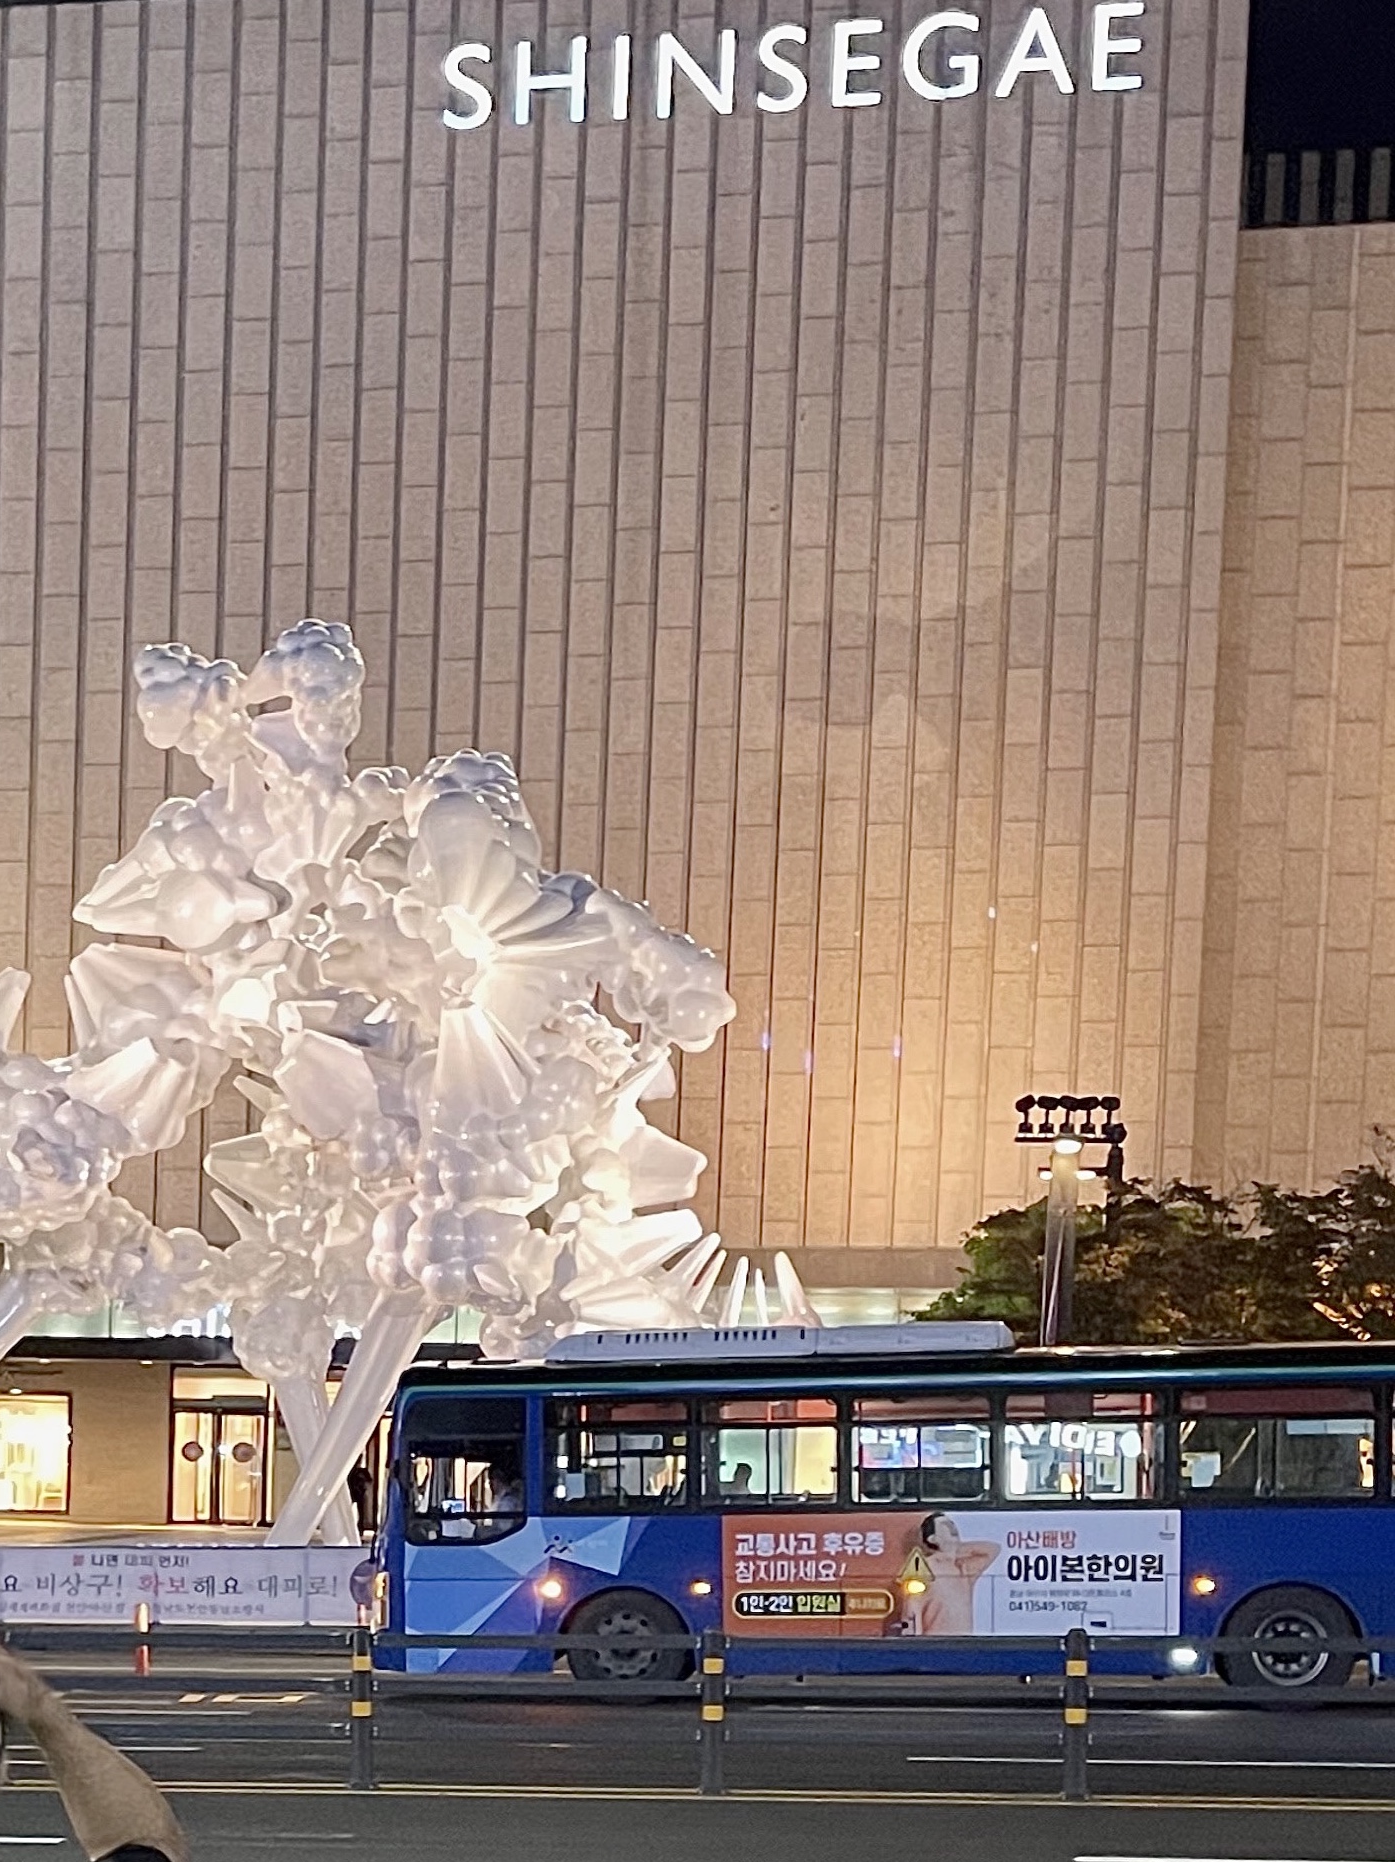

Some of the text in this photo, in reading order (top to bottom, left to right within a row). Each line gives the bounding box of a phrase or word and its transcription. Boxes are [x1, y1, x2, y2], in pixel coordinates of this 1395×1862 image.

[442, 2, 1145, 131] SHINSEGAE
[735, 1532, 885, 1557] 교통사고 후유증
[1007, 1530, 1077, 1549] 아산배방
[735, 1560, 847, 1584] 참지마세요!
[1007, 1554, 1164, 1582] 아이본한의원
[36, 1573, 122, 1597] 비상구!
[258, 1574, 337, 1597] 대피로!
